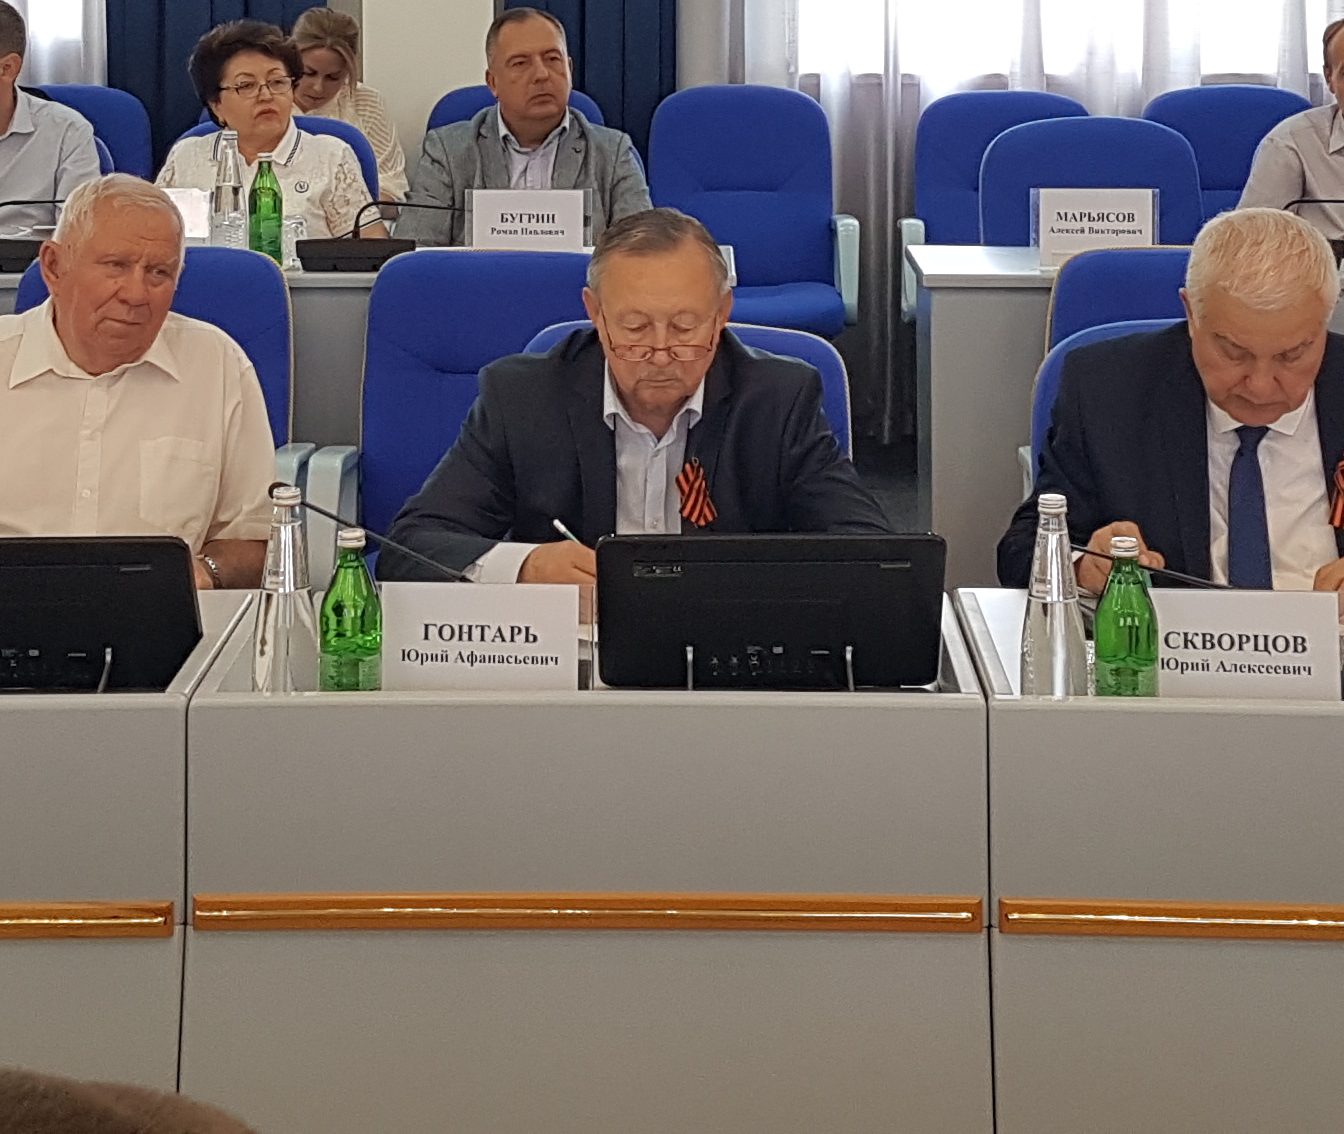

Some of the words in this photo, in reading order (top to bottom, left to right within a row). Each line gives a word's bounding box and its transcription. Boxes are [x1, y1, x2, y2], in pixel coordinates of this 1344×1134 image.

[501, 213, 556, 224] БУГРИН
[1055, 211, 1136, 223] МАРЬЯСОВ
[491, 227, 518, 236] Роман
[521, 227, 565, 236] Павлович
[1048, 226, 1086, 235] Алексей
[1088, 226, 1143, 237] Викторович
[422, 622, 539, 644] ГОНТАРЬ
[1163, 631, 1308, 656] СКВОРЦОВ
[401, 648, 449, 666] Юрий
[454, 650, 559, 667] Афанасьевич
[1160, 657, 1210, 674] Юрий
[1214, 660, 1312, 676] Алексеевич
